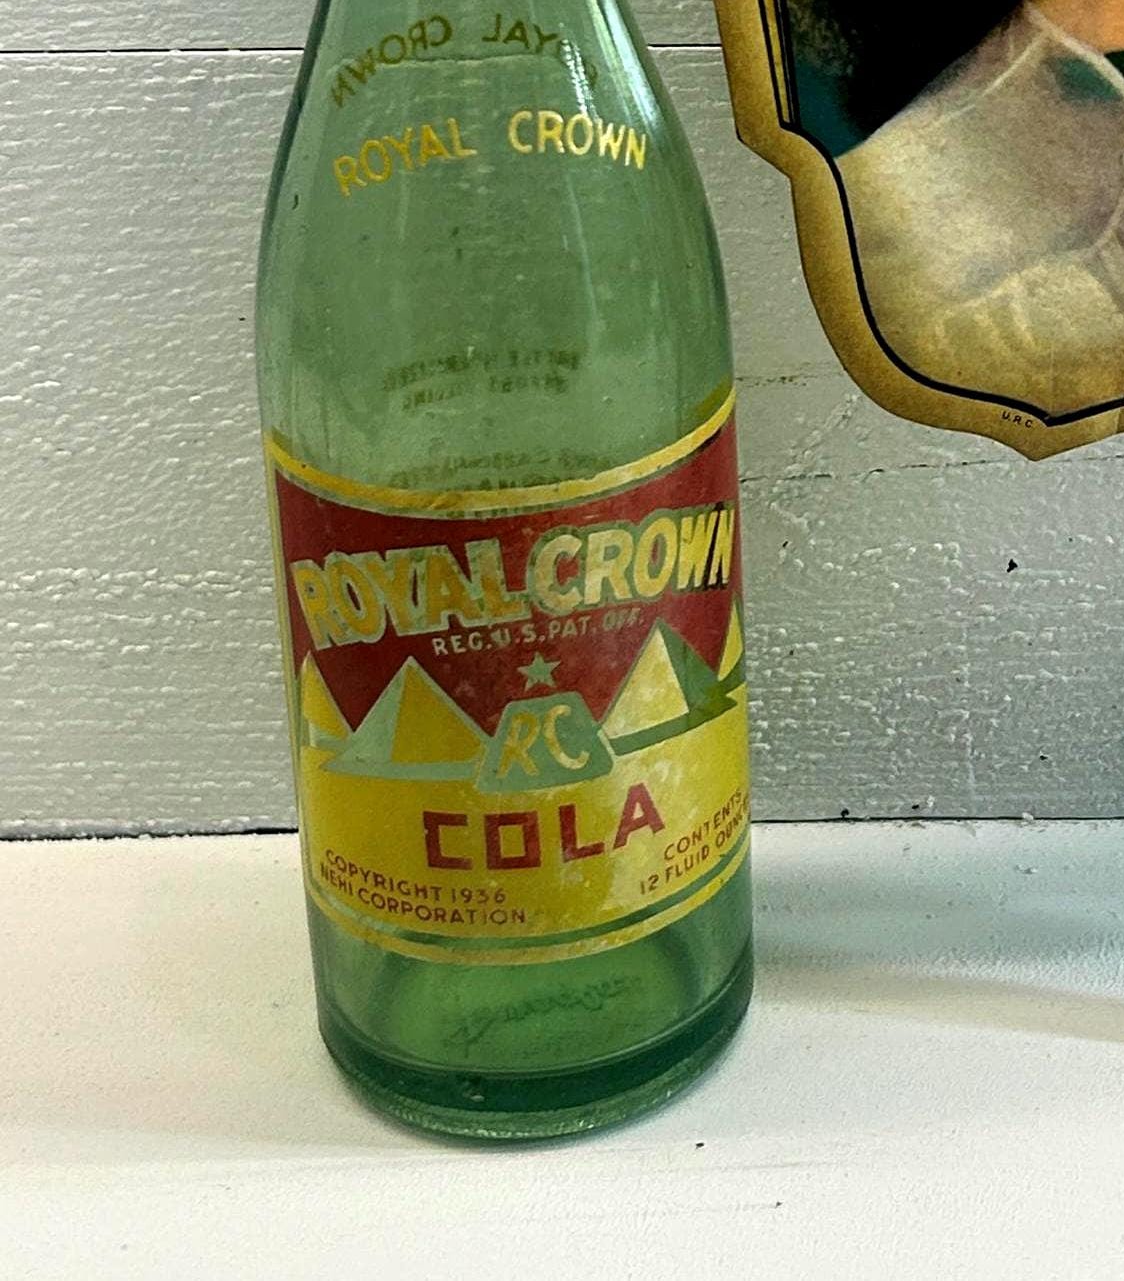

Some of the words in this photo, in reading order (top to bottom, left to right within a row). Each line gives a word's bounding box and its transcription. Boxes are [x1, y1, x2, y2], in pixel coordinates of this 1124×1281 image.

[331, 116, 479, 198] ROYAL
[508, 109, 648, 170] CROWN
[291, 537, 531, 651] ROYAL
[527, 505, 737, 614] CROWN
[498, 703, 590, 781] RC
[420, 782, 666, 872] COLA
[663, 787, 742, 861] CONTENTS
[320, 862, 354, 897] NEHI
[357, 886, 525, 925] CORPORATION
[325, 848, 442, 902] COPYRIGHT
[451, 887, 506, 904] 1936
[640, 873, 660, 896] 12
[664, 843, 711, 884] FLUID
